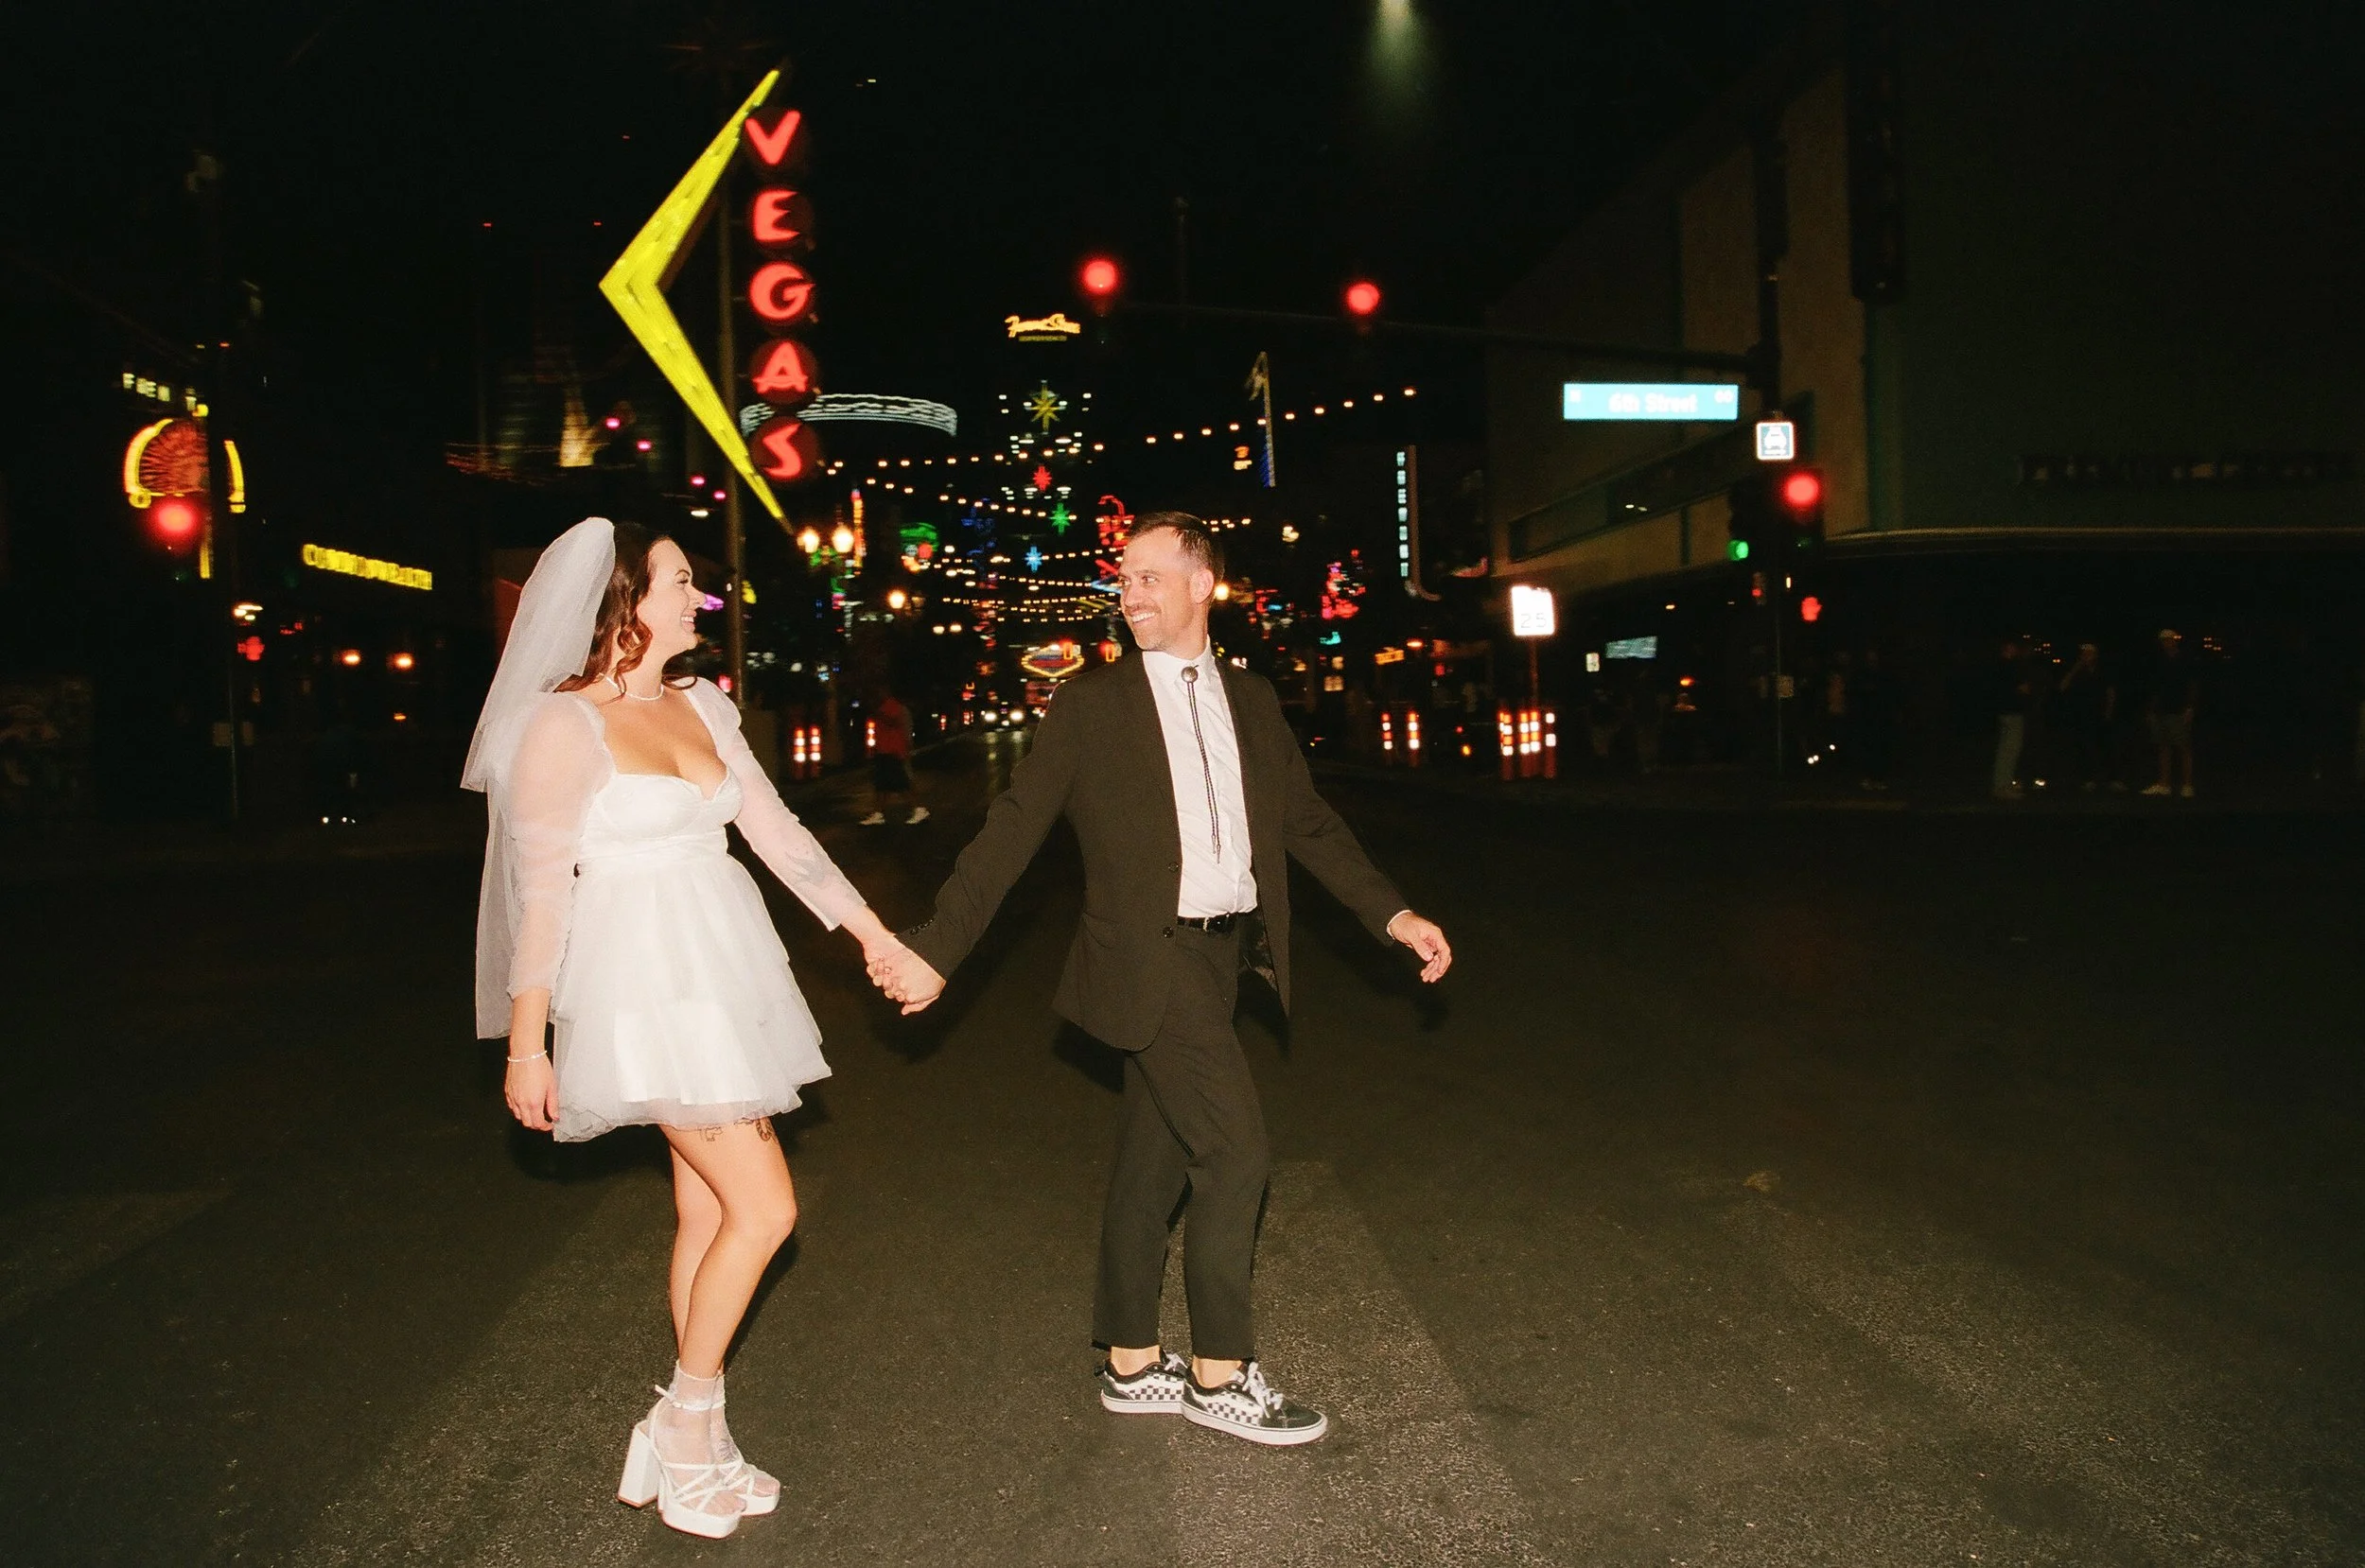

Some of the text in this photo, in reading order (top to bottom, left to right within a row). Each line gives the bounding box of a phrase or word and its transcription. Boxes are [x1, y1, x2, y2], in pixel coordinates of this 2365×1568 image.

[745, 109, 815, 480] VEGAS
[1608, 392, 1640, 412] 6th
[1645, 392, 1698, 412] Street
[1520, 612, 1548, 629] 25
